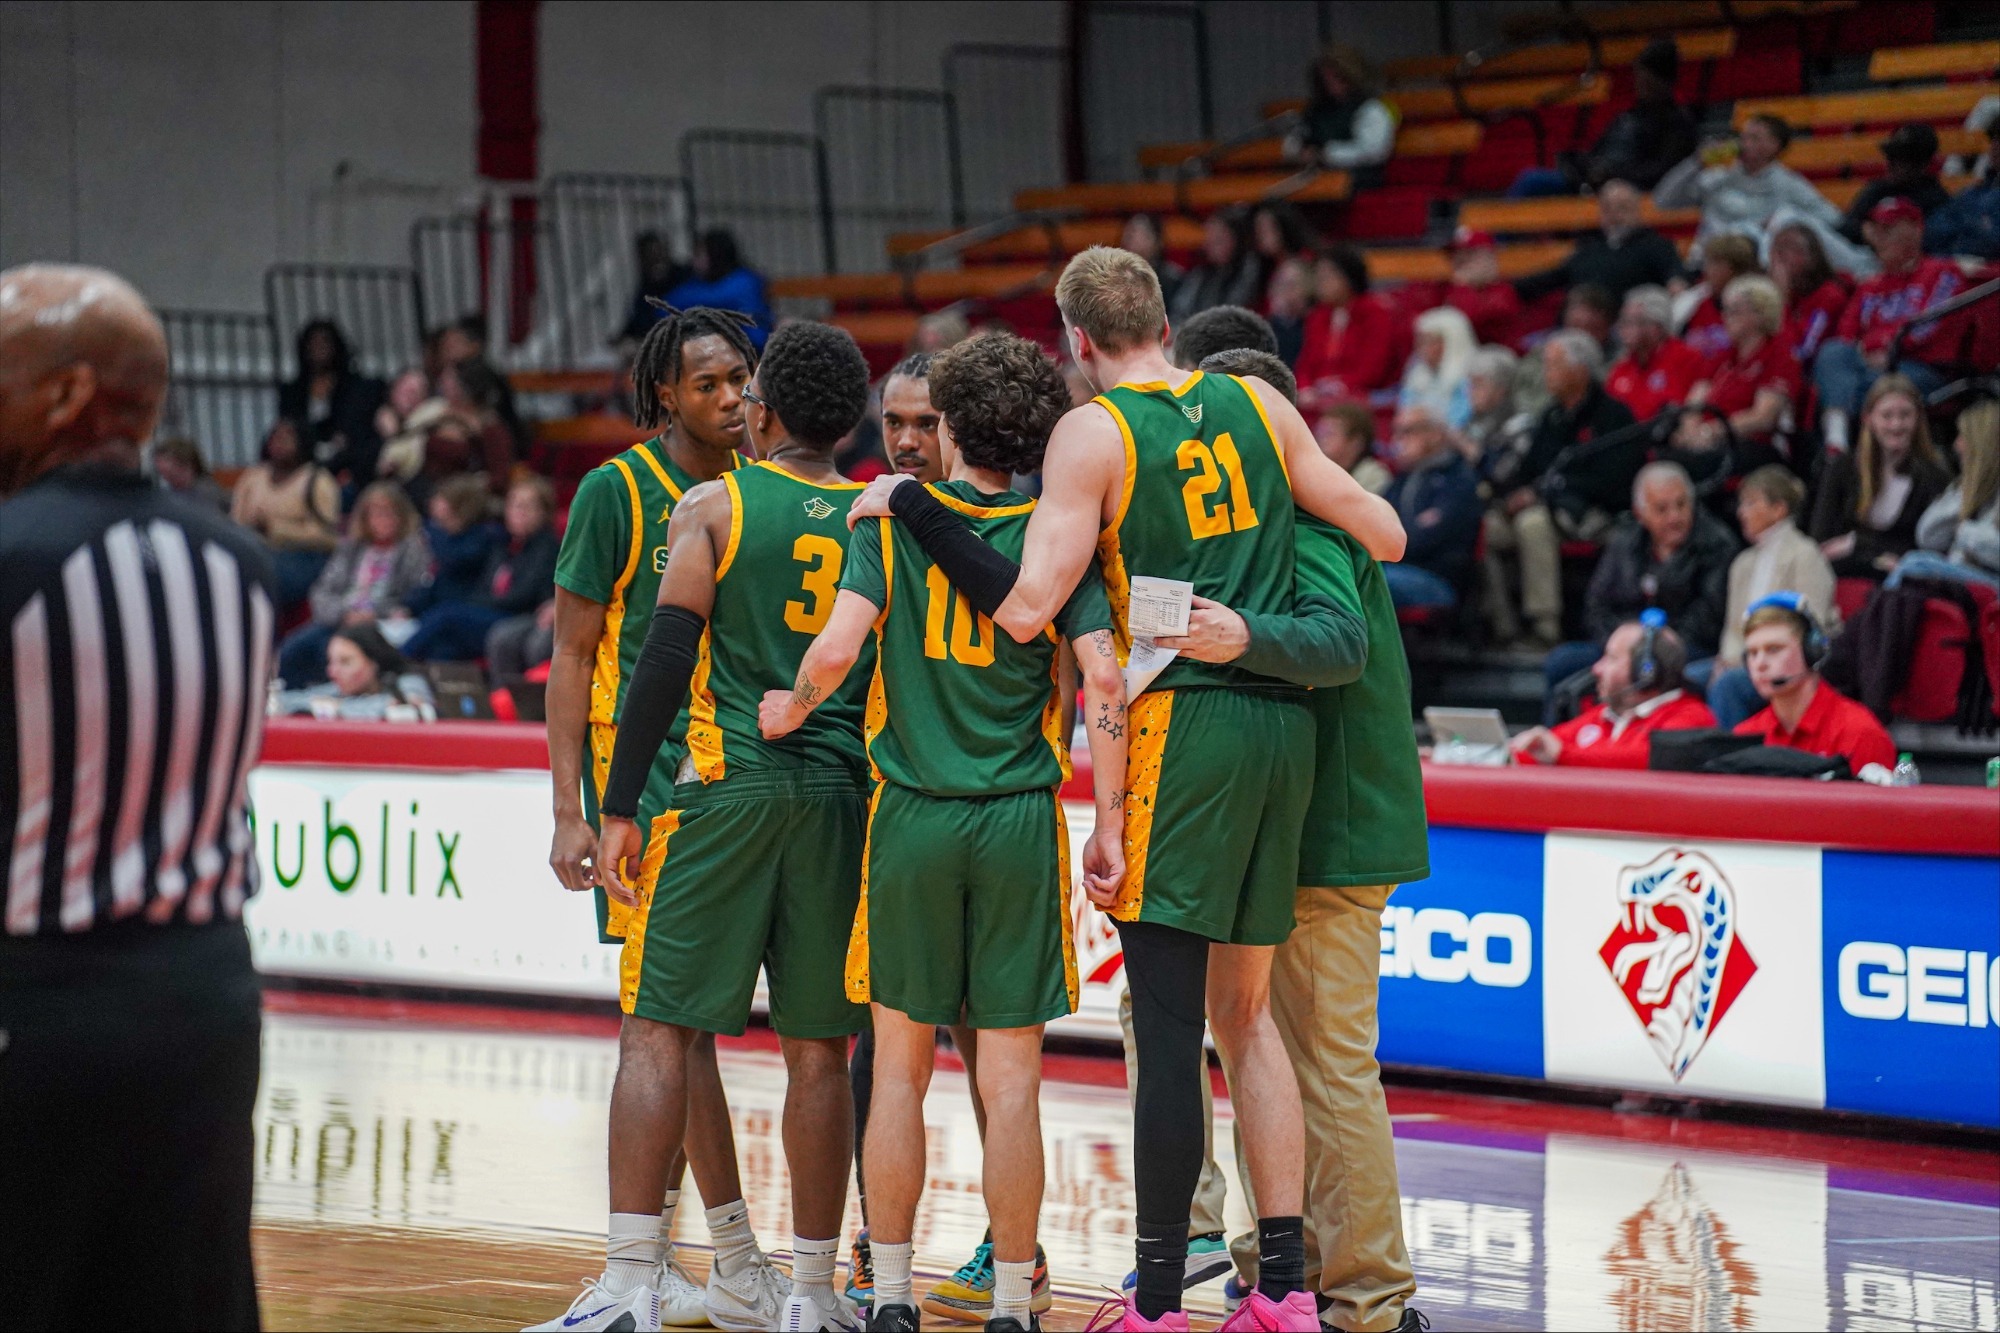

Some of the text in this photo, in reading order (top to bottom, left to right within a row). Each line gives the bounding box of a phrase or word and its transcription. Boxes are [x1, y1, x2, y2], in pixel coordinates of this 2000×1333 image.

[1176, 432, 1259, 540] 21
[784, 533, 843, 635] 3
[924, 563, 996, 668] 10
[249, 796, 463, 901] ublix
[1838, 940, 2000, 1028] GEI
